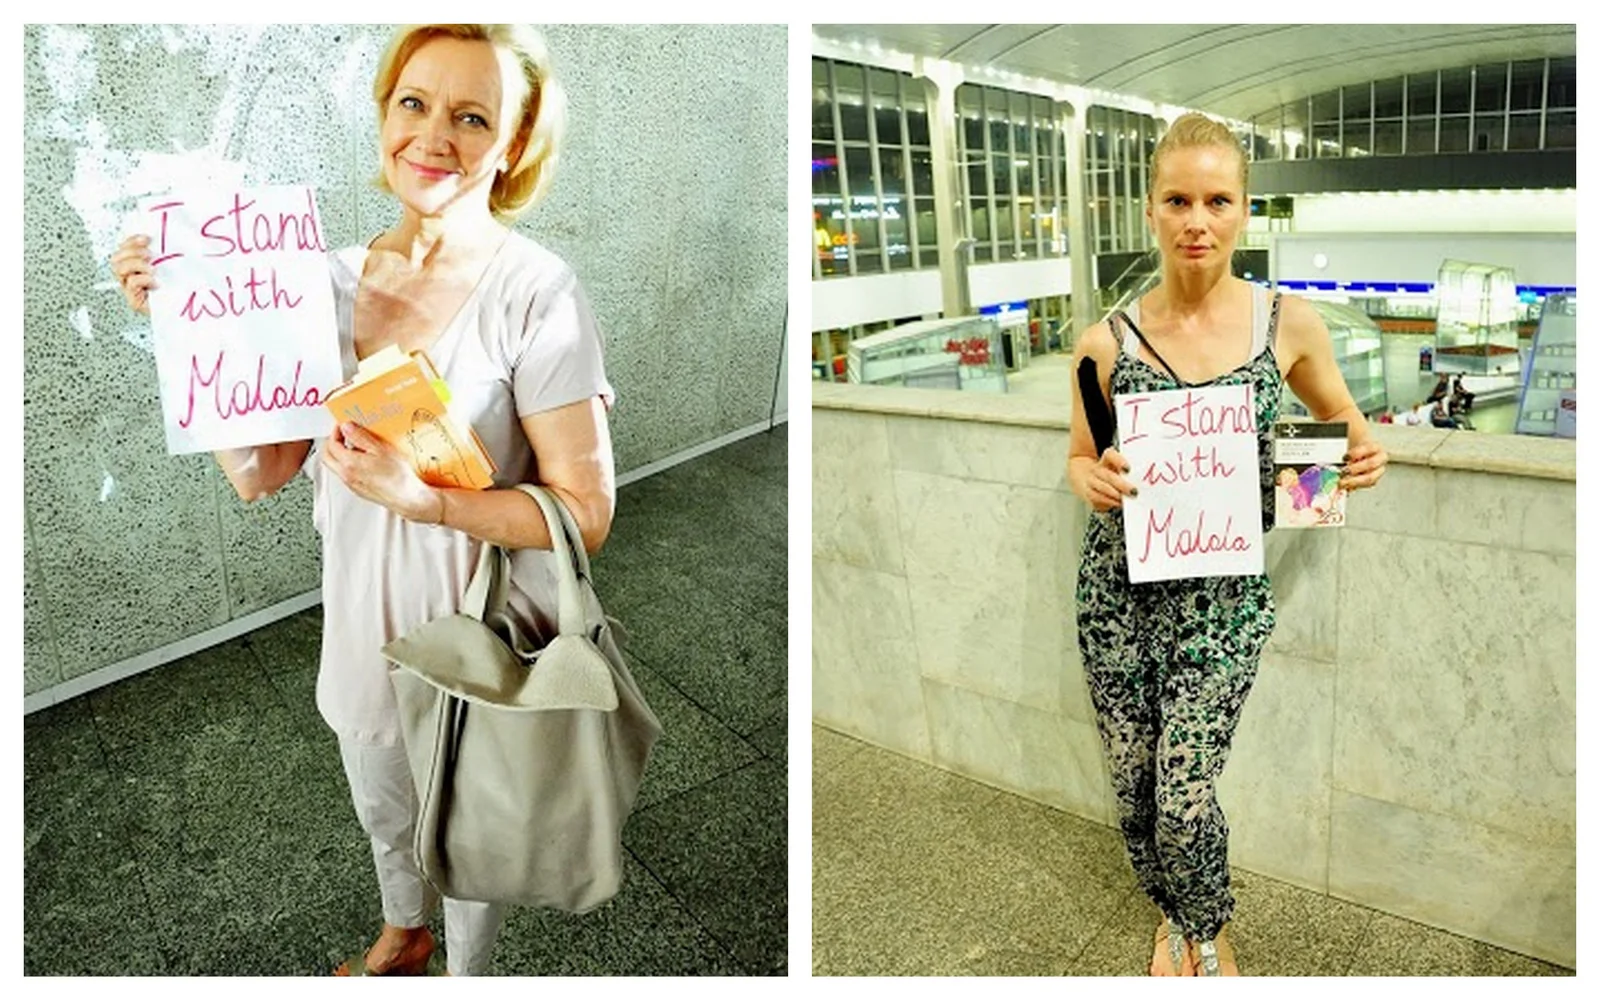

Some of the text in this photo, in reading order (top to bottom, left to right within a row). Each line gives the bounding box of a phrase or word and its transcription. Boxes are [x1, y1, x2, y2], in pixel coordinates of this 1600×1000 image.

[149, 189, 326, 266] I stand
[179, 267, 303, 321] with
[179, 351, 327, 429] Malala
[1122, 385, 1257, 444] I stand
[1142, 446, 1236, 486] with
[1138, 507, 1251, 563] Malala
